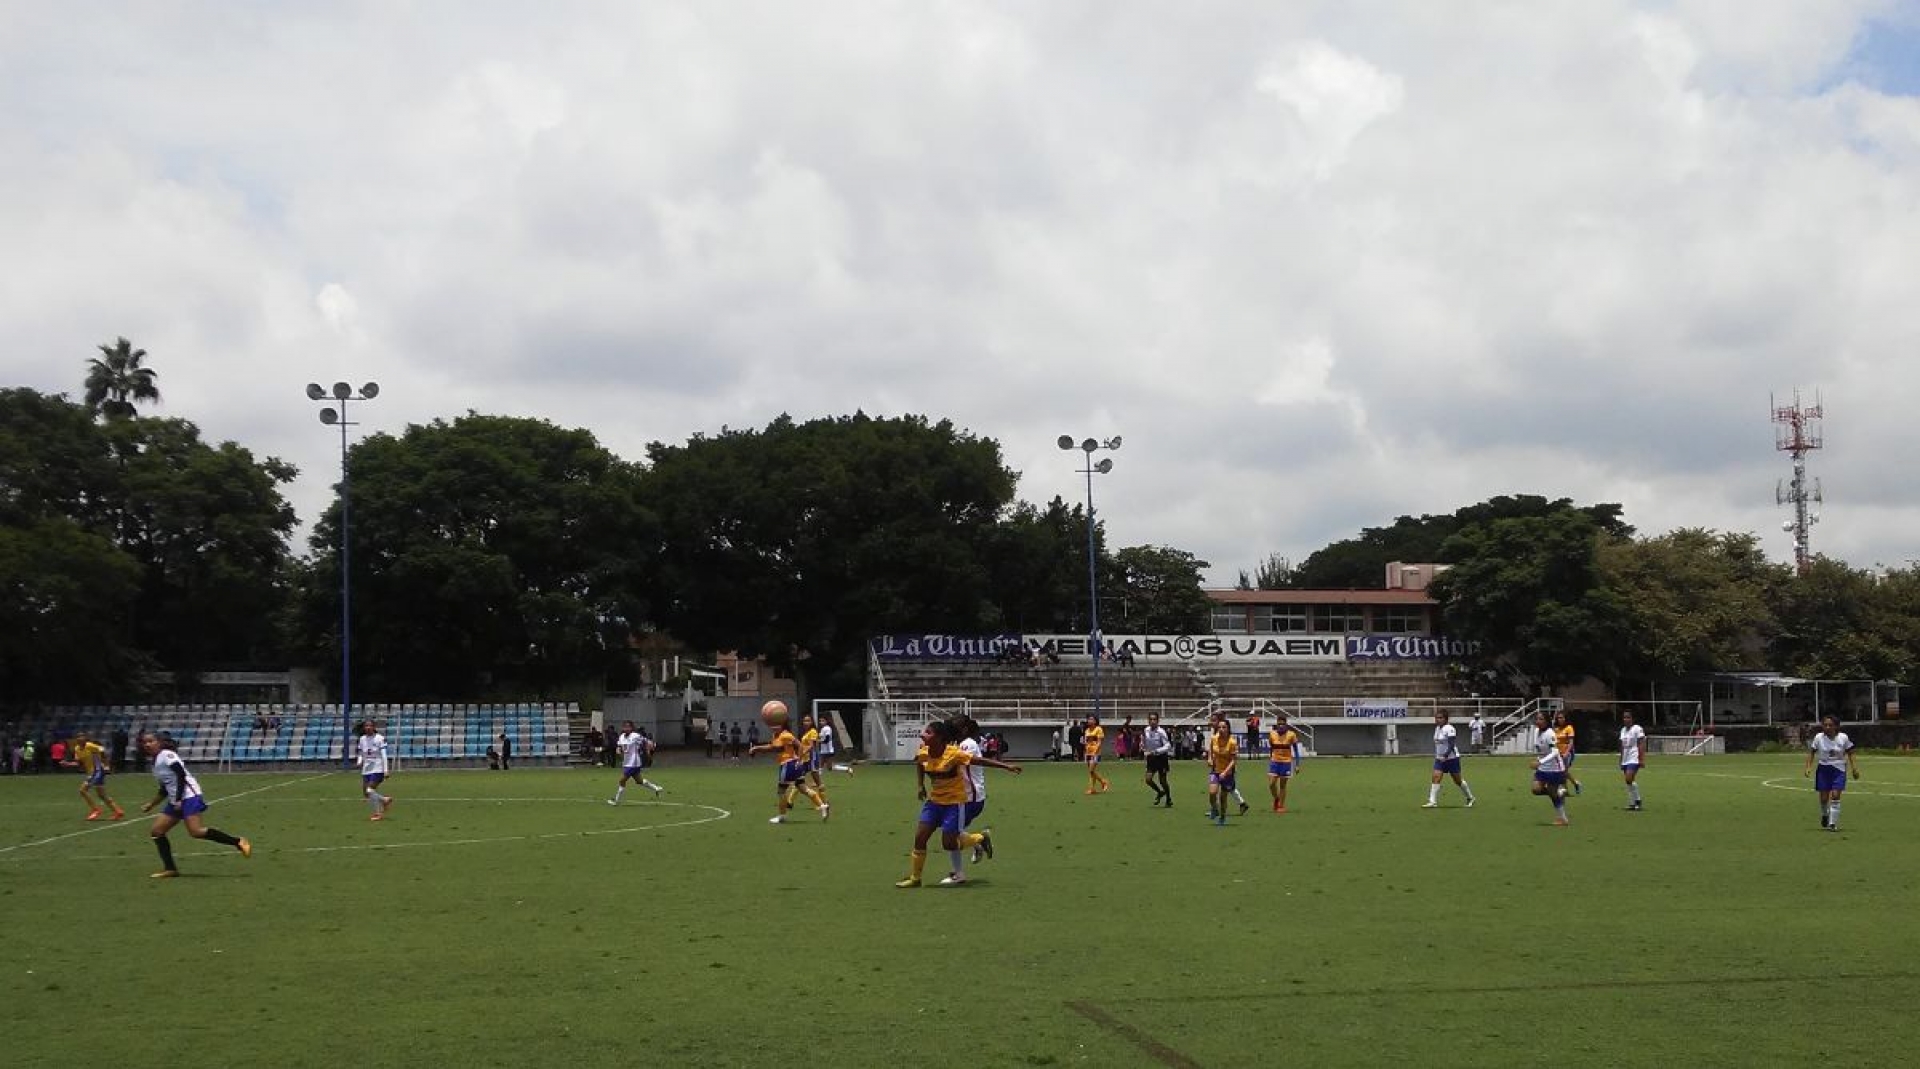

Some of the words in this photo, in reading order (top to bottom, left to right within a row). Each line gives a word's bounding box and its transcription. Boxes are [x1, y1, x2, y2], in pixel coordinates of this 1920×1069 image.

[877, 634, 921, 656] La
[1230, 639, 1339, 655] UAEM
[1348, 636, 1390, 657] La
